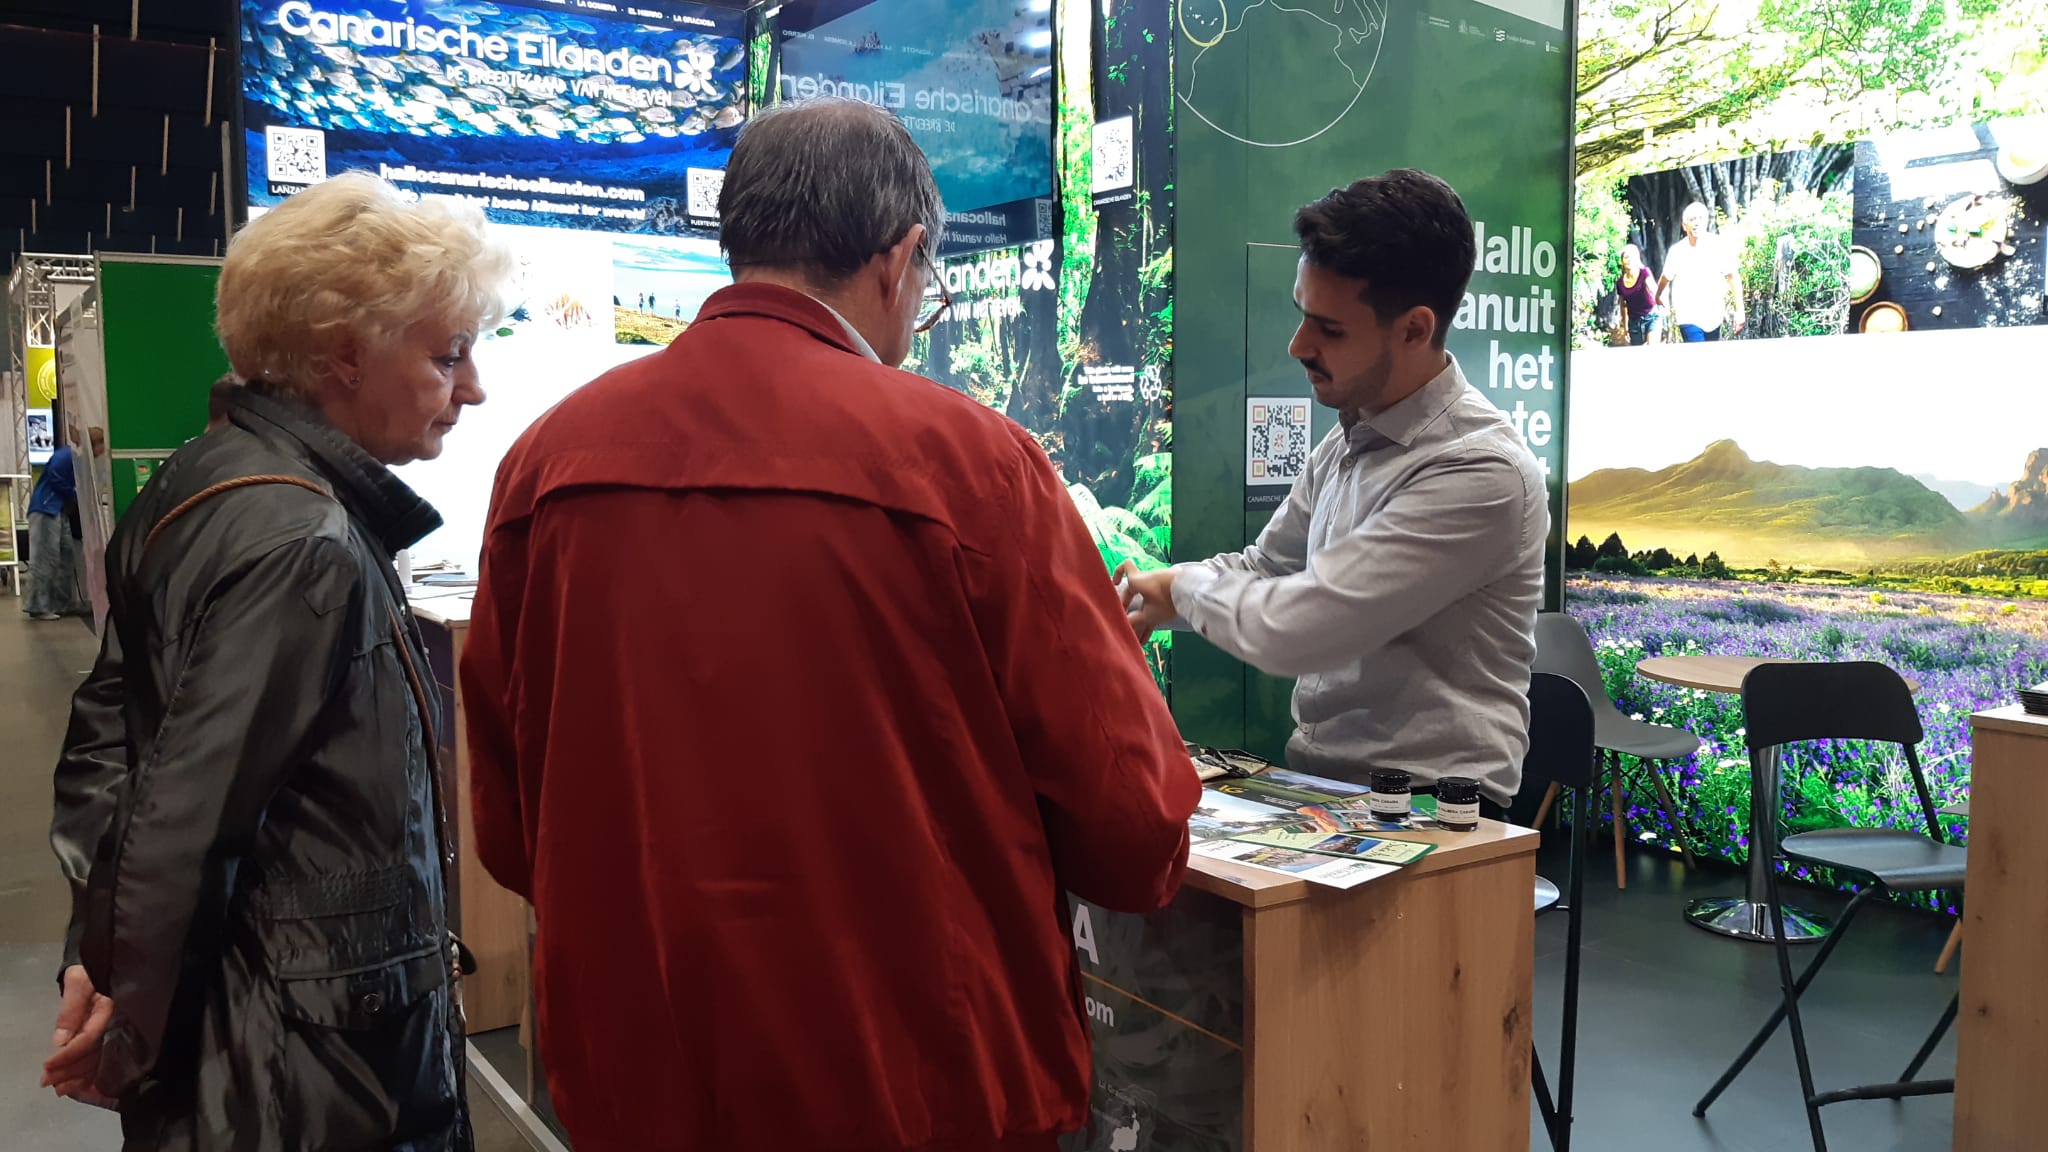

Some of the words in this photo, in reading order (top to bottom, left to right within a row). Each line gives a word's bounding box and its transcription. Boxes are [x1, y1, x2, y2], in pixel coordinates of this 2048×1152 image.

[278, 1, 509, 62] Canarische
[518, 32, 673, 84] Eilanden
[1452, 285, 1556, 334] anuit
[1489, 340, 1554, 390] het
[1073, 904, 1099, 965] A
[1085, 996, 1115, 1028] om
